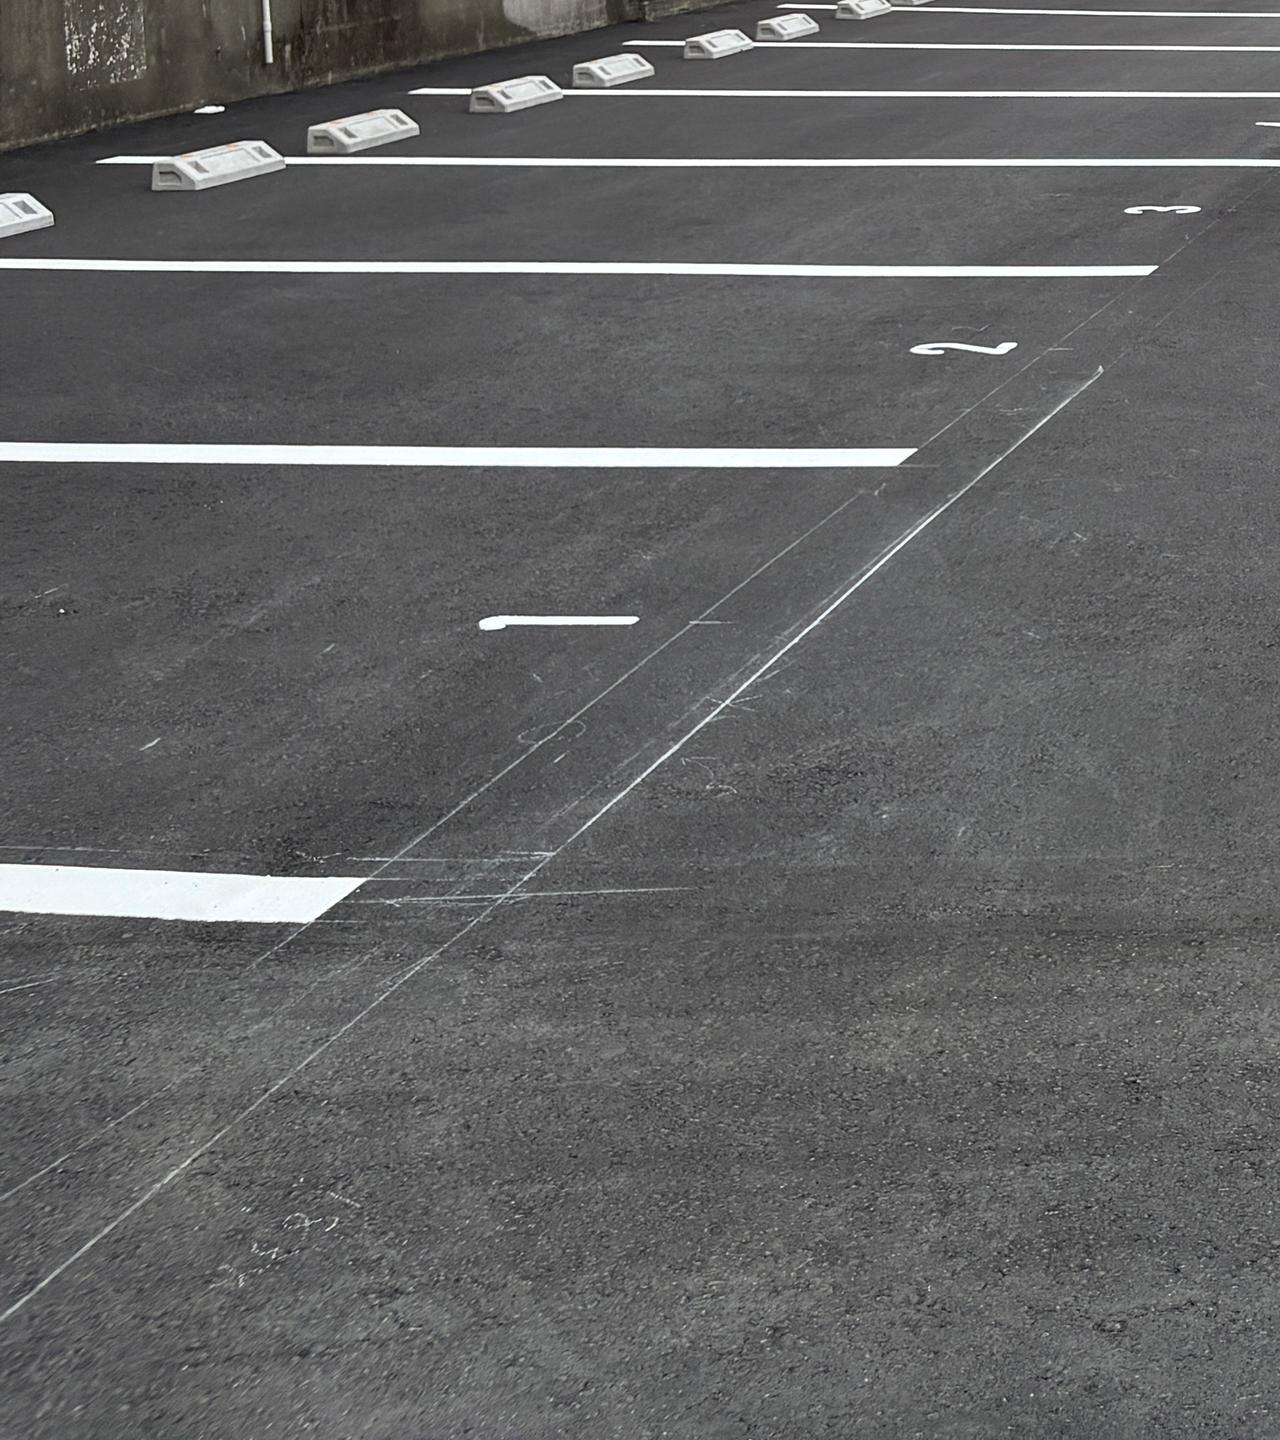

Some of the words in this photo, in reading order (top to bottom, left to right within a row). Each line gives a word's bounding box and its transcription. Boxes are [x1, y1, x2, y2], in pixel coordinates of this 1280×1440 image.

[1123, 205, 1202, 215] 3
[909, 340, 1019, 356] 2
[477, 613, 640, 632] 1
